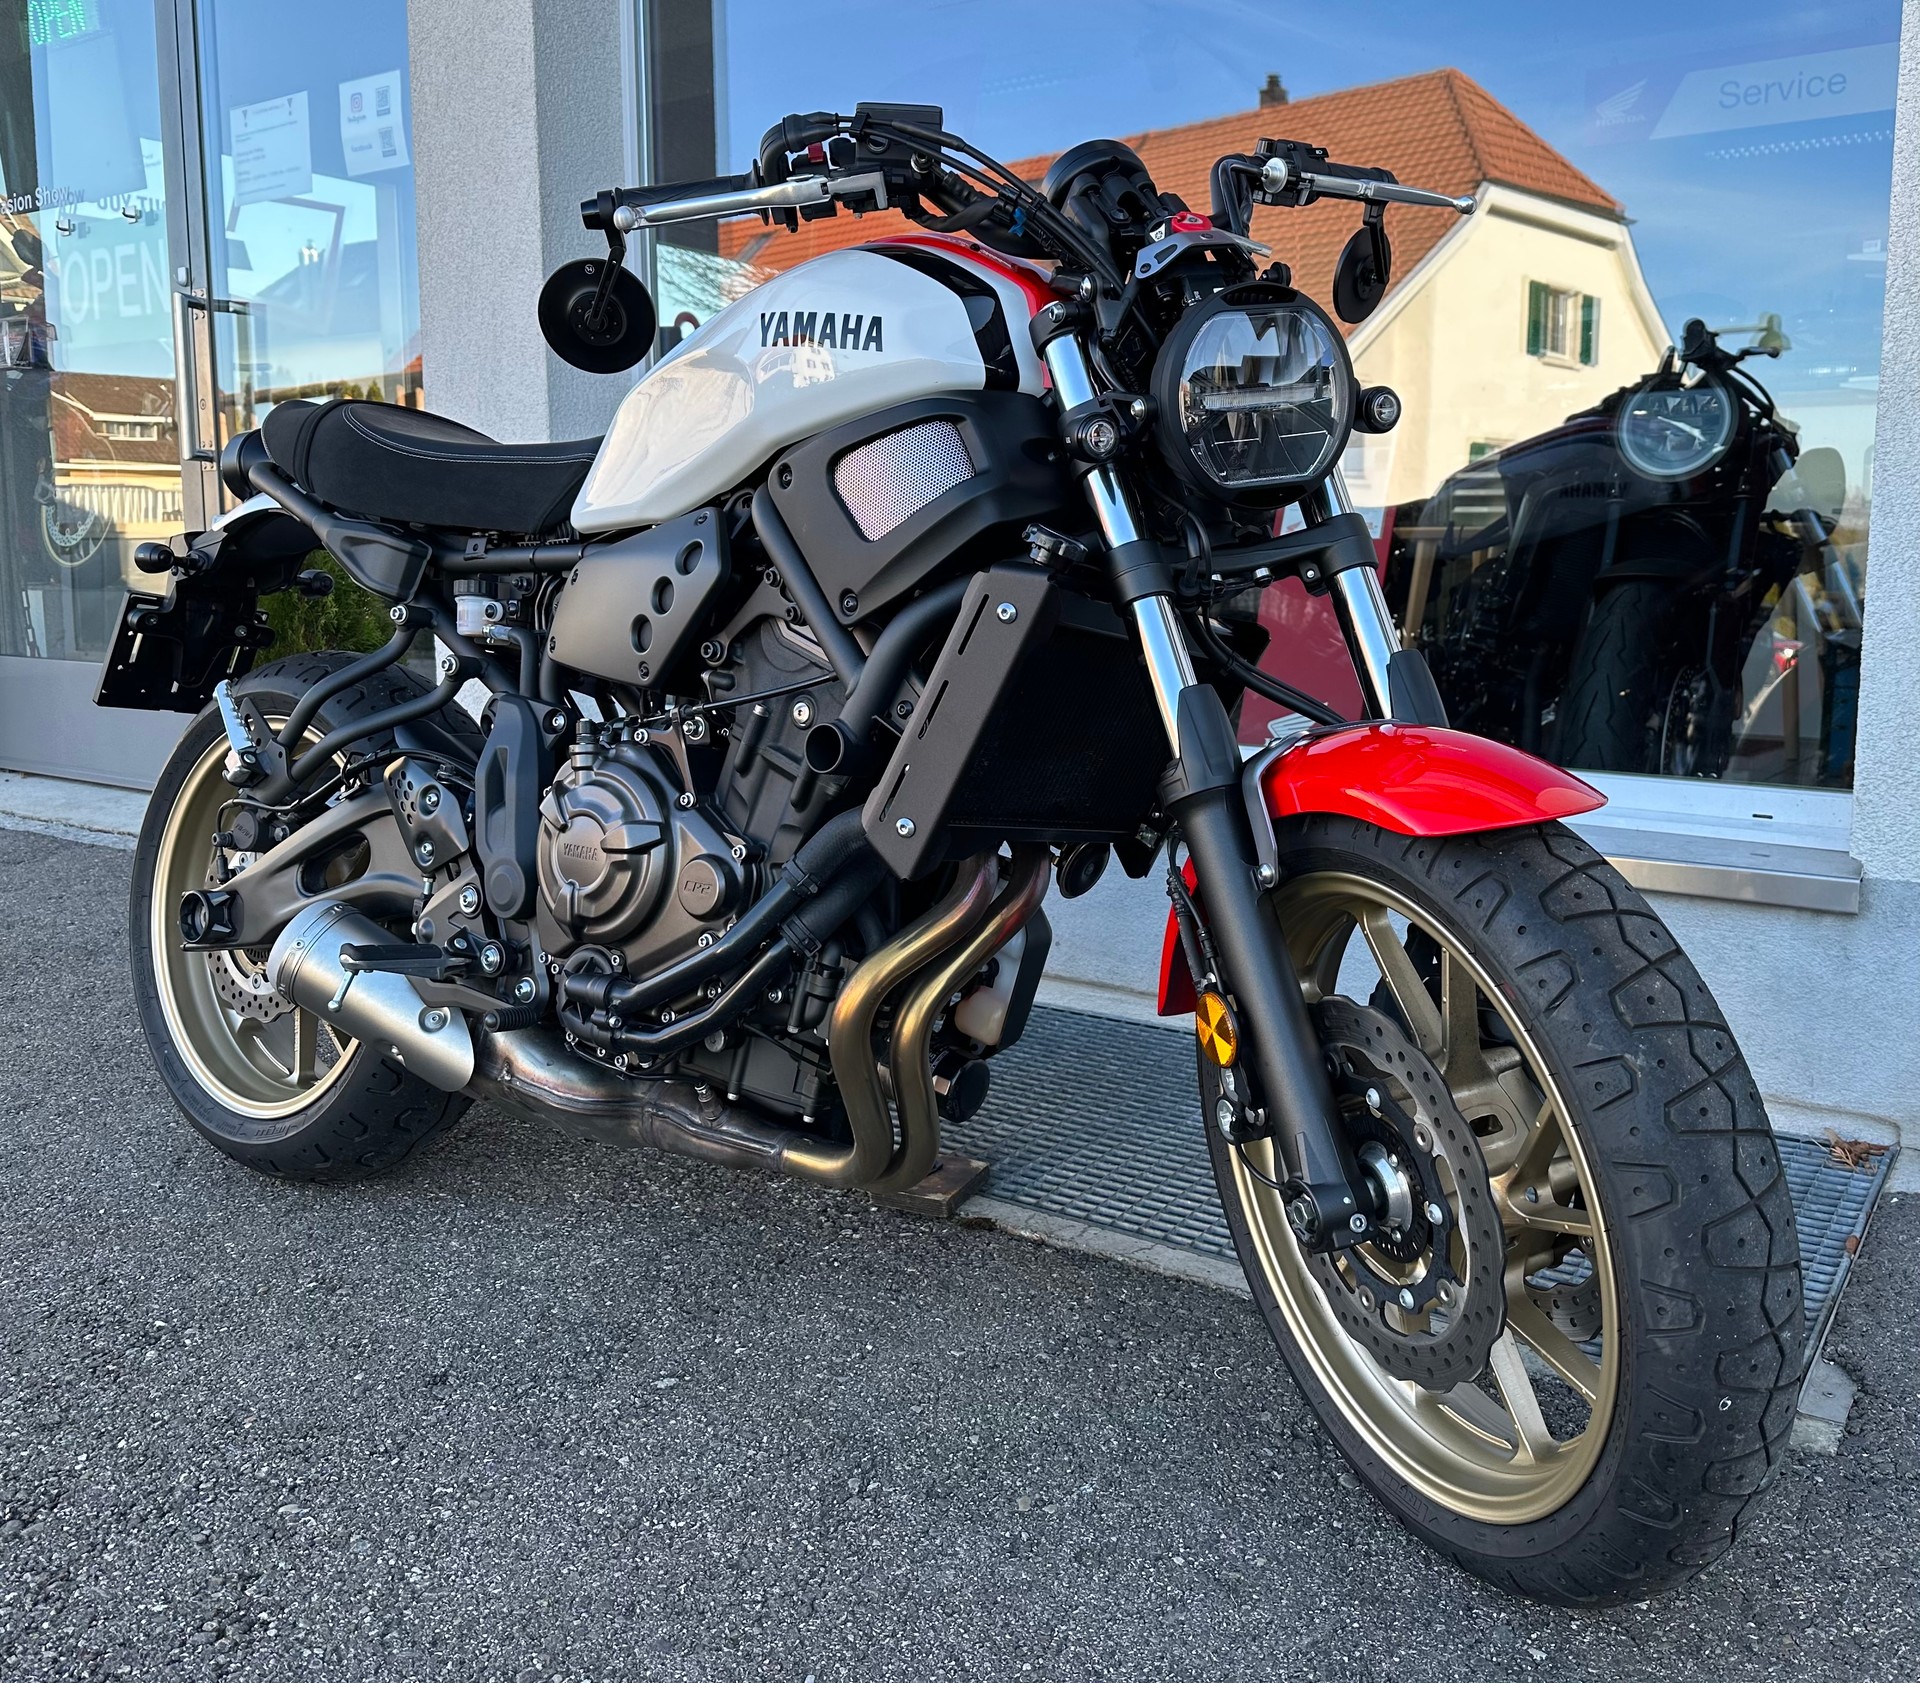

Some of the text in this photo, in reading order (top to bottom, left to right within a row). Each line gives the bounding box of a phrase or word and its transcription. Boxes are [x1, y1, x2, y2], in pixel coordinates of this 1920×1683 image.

[29, 0, 86, 45] OPEN
[1718, 71, 1847, 109] Service
[63, 238, 171, 324] OPEN
[760, 311, 883, 352] YAMAHA
[563, 842, 598, 861] YAMAHA
[683, 880, 713, 894] CP2
